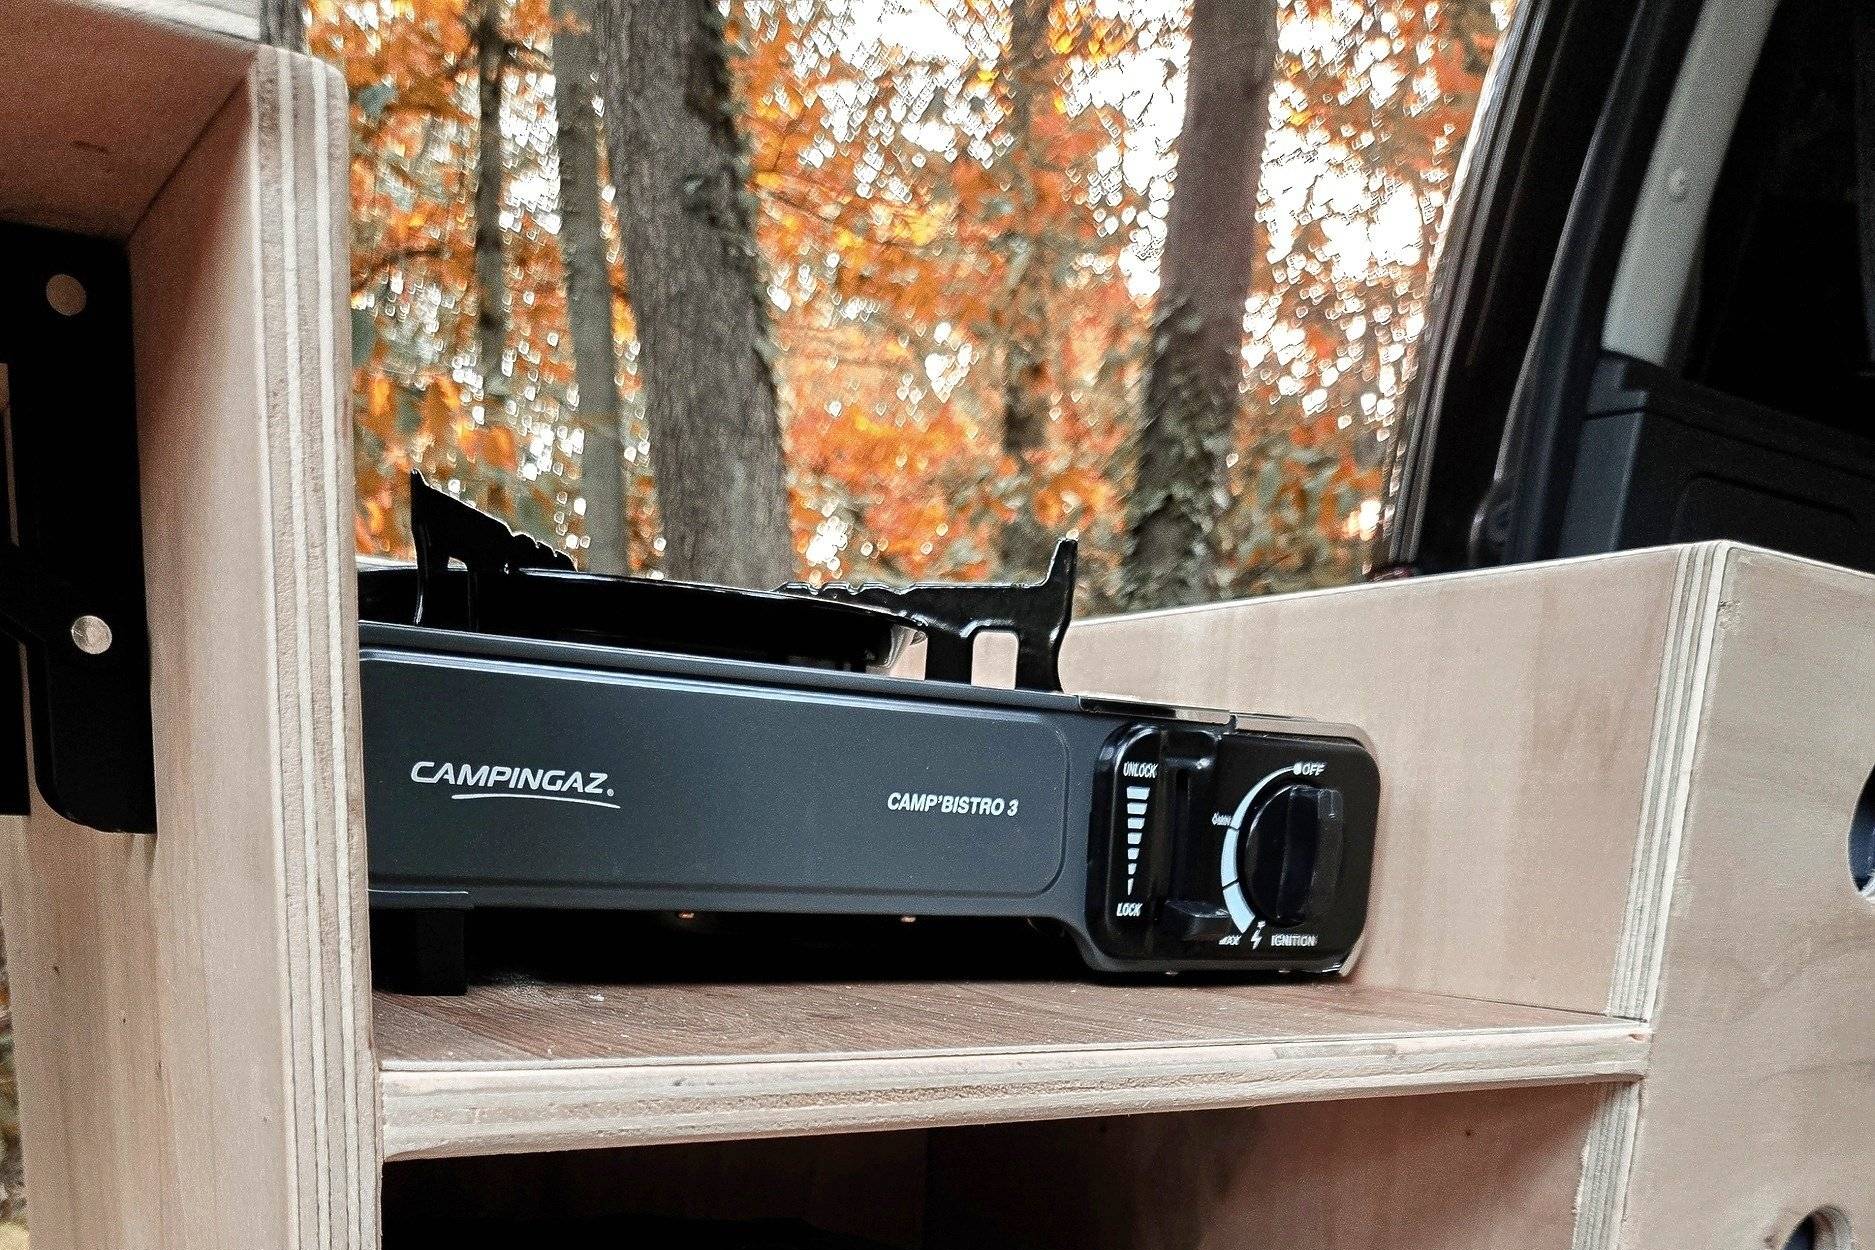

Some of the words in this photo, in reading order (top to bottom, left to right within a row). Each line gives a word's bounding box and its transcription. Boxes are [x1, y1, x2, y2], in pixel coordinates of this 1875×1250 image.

[1123, 761, 1159, 778] UNLOCK
[1302, 762, 1327, 776] OFF
[887, 792, 1005, 816] CAMP'BISTRO
[1007, 798, 1019, 817] 3
[1116, 902, 1143, 917] LOCK
[1270, 934, 1319, 947] IGNITION
